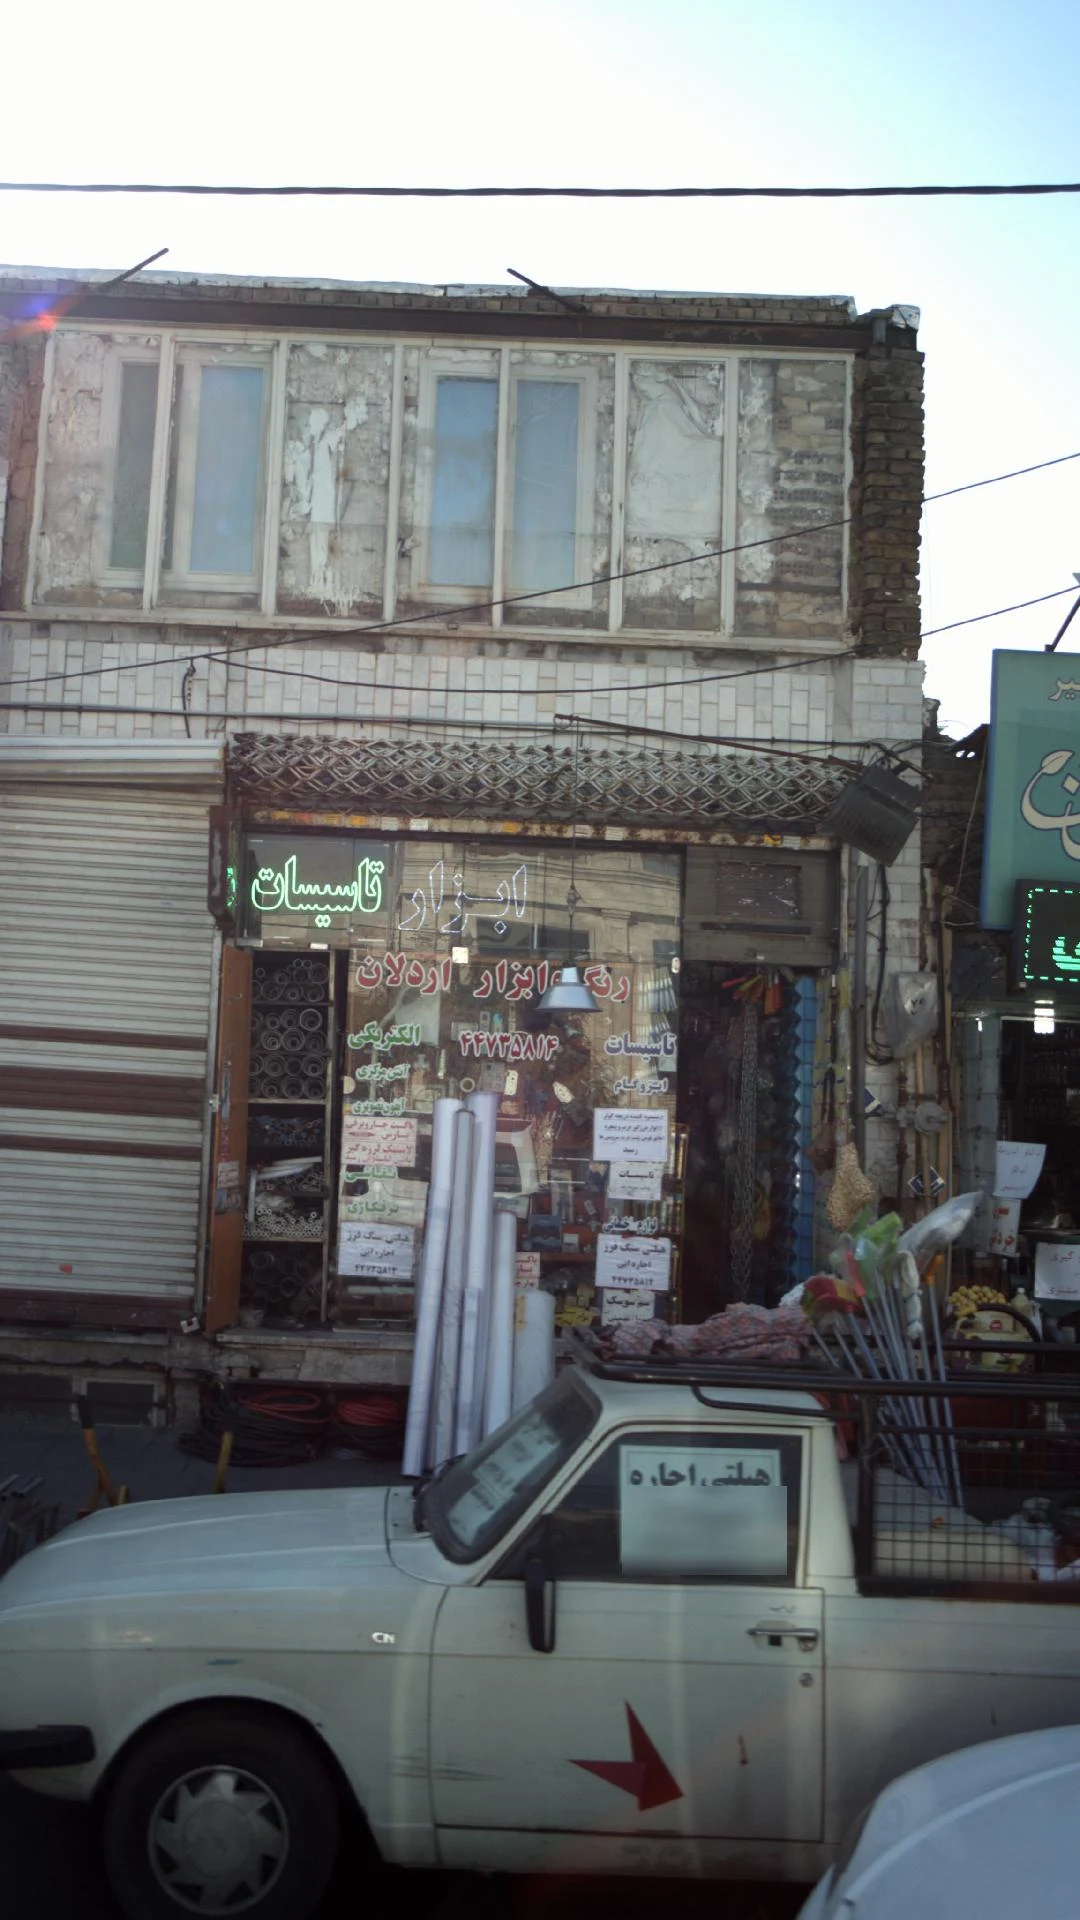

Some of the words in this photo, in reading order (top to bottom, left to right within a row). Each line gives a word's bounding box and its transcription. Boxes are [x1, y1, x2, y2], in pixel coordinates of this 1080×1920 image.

[251, 855, 384, 928] تاسیسات
[398, 860, 527, 934] ابزار
[356, 952, 452, 995] اردلان
[473, 959, 549, 1000] ابزار
[347, 1020, 421, 1051] الکتریکی
[459, 1029, 560, 1062] ۴۴۷۳۵۸۱۴
[604, 1032, 677, 1063] تاسیسات
